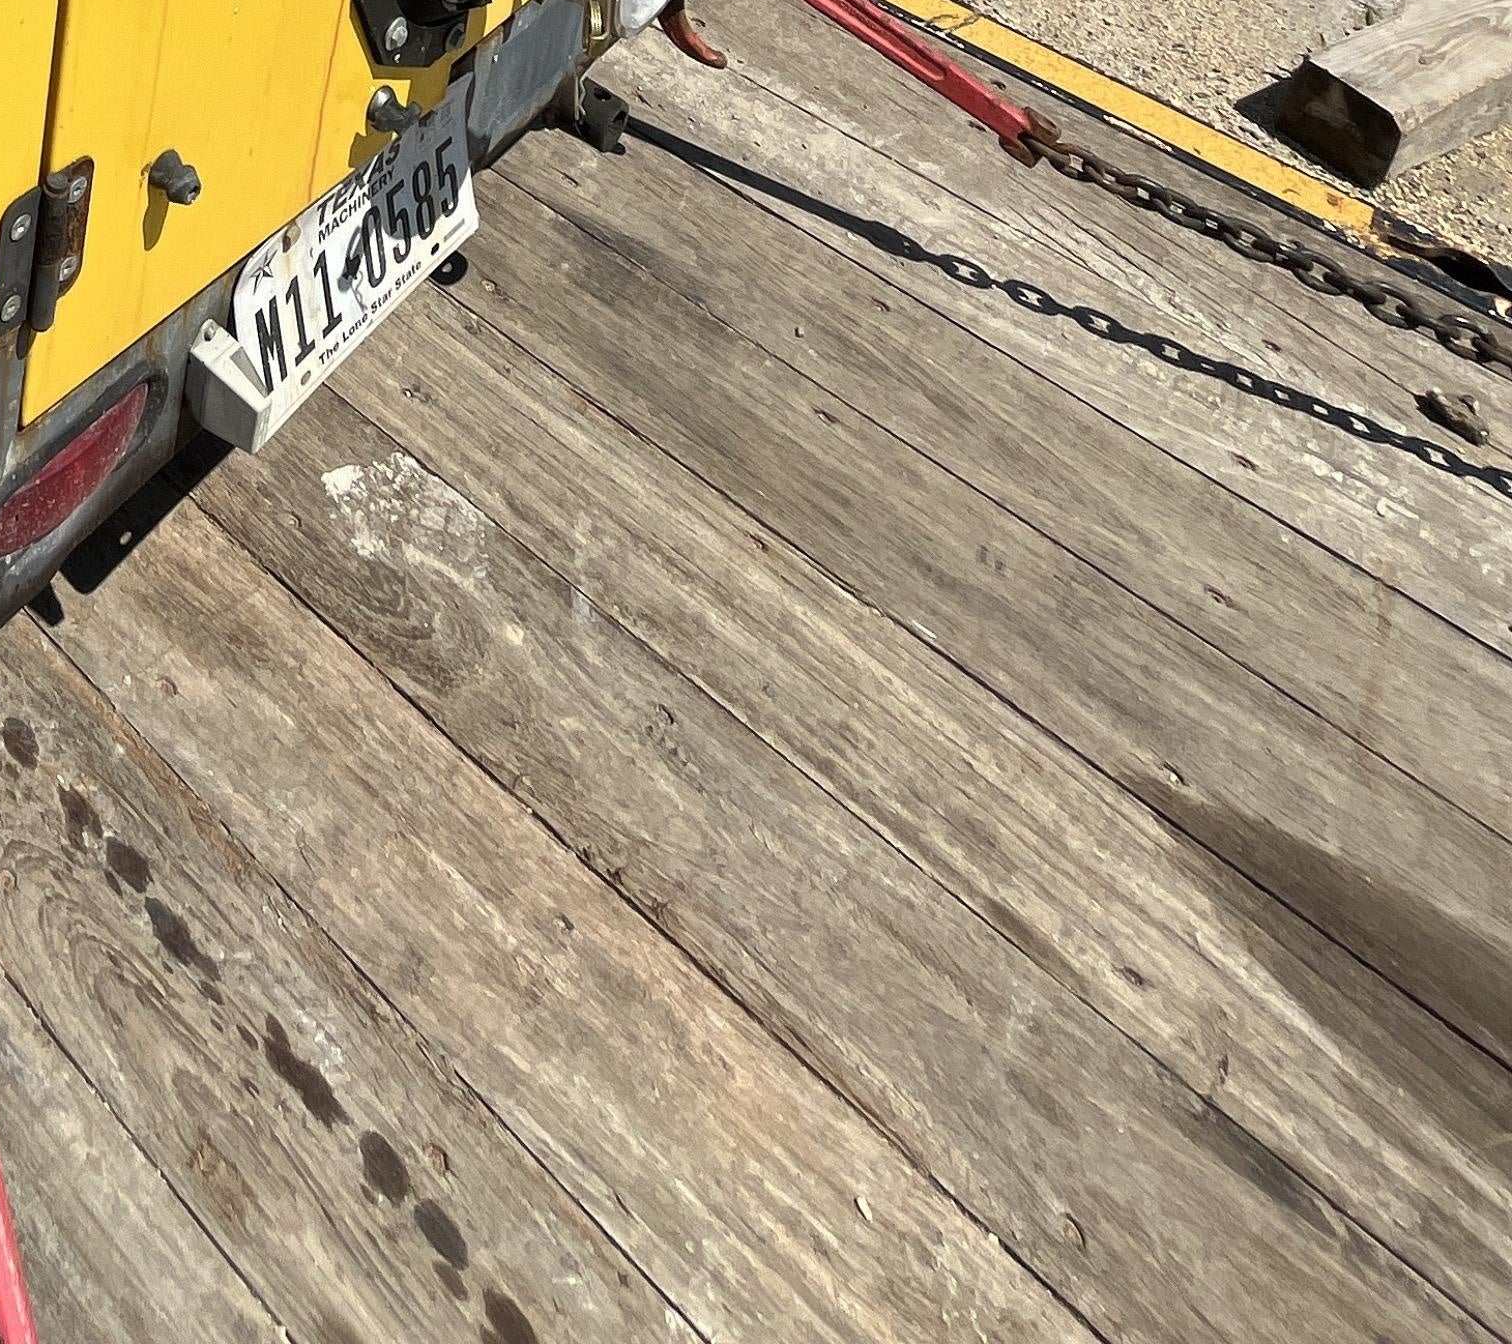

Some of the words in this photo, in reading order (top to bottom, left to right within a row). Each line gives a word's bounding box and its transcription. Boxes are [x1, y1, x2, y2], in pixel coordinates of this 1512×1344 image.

[316, 141, 401, 225] TEXAS
[318, 169, 395, 245] MACHINERY
[254, 250, 343, 396] M11
[361, 136, 459, 289] 0585
[319, 341, 340, 365] The
[342, 314, 369, 344] Lone
[371, 288, 393, 314] Star
[395, 260, 422, 291] State
